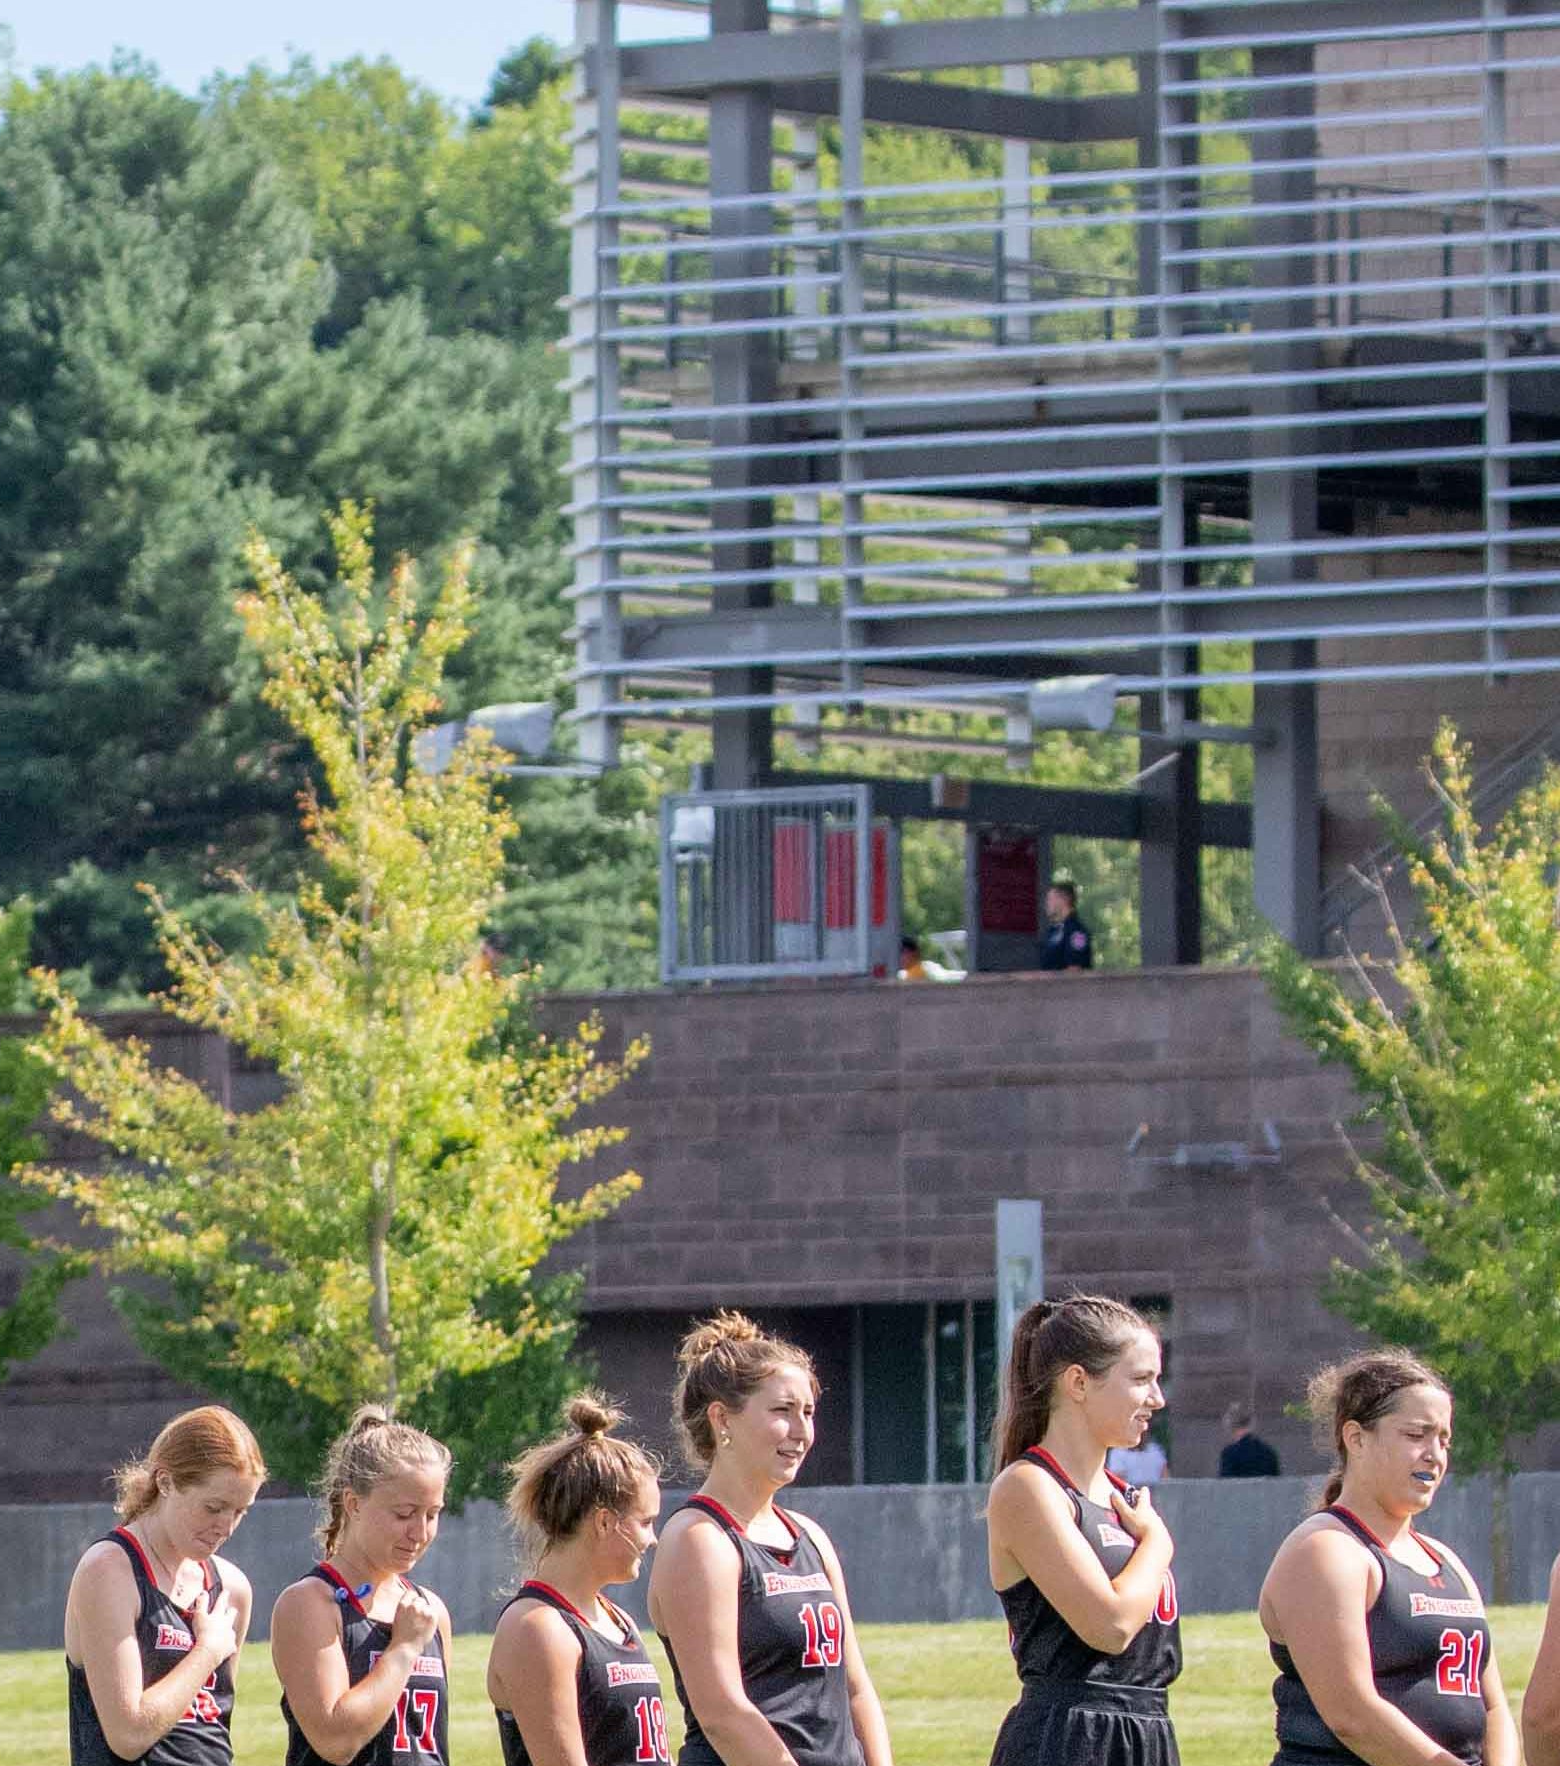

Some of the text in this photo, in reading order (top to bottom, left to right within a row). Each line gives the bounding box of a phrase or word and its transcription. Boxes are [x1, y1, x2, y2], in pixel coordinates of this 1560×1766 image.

[798, 1601, 842, 1667] 19
[1436, 1628, 1483, 1697] 21
[393, 1689, 439, 1754] 17
[634, 1696, 670, 1762] 18
